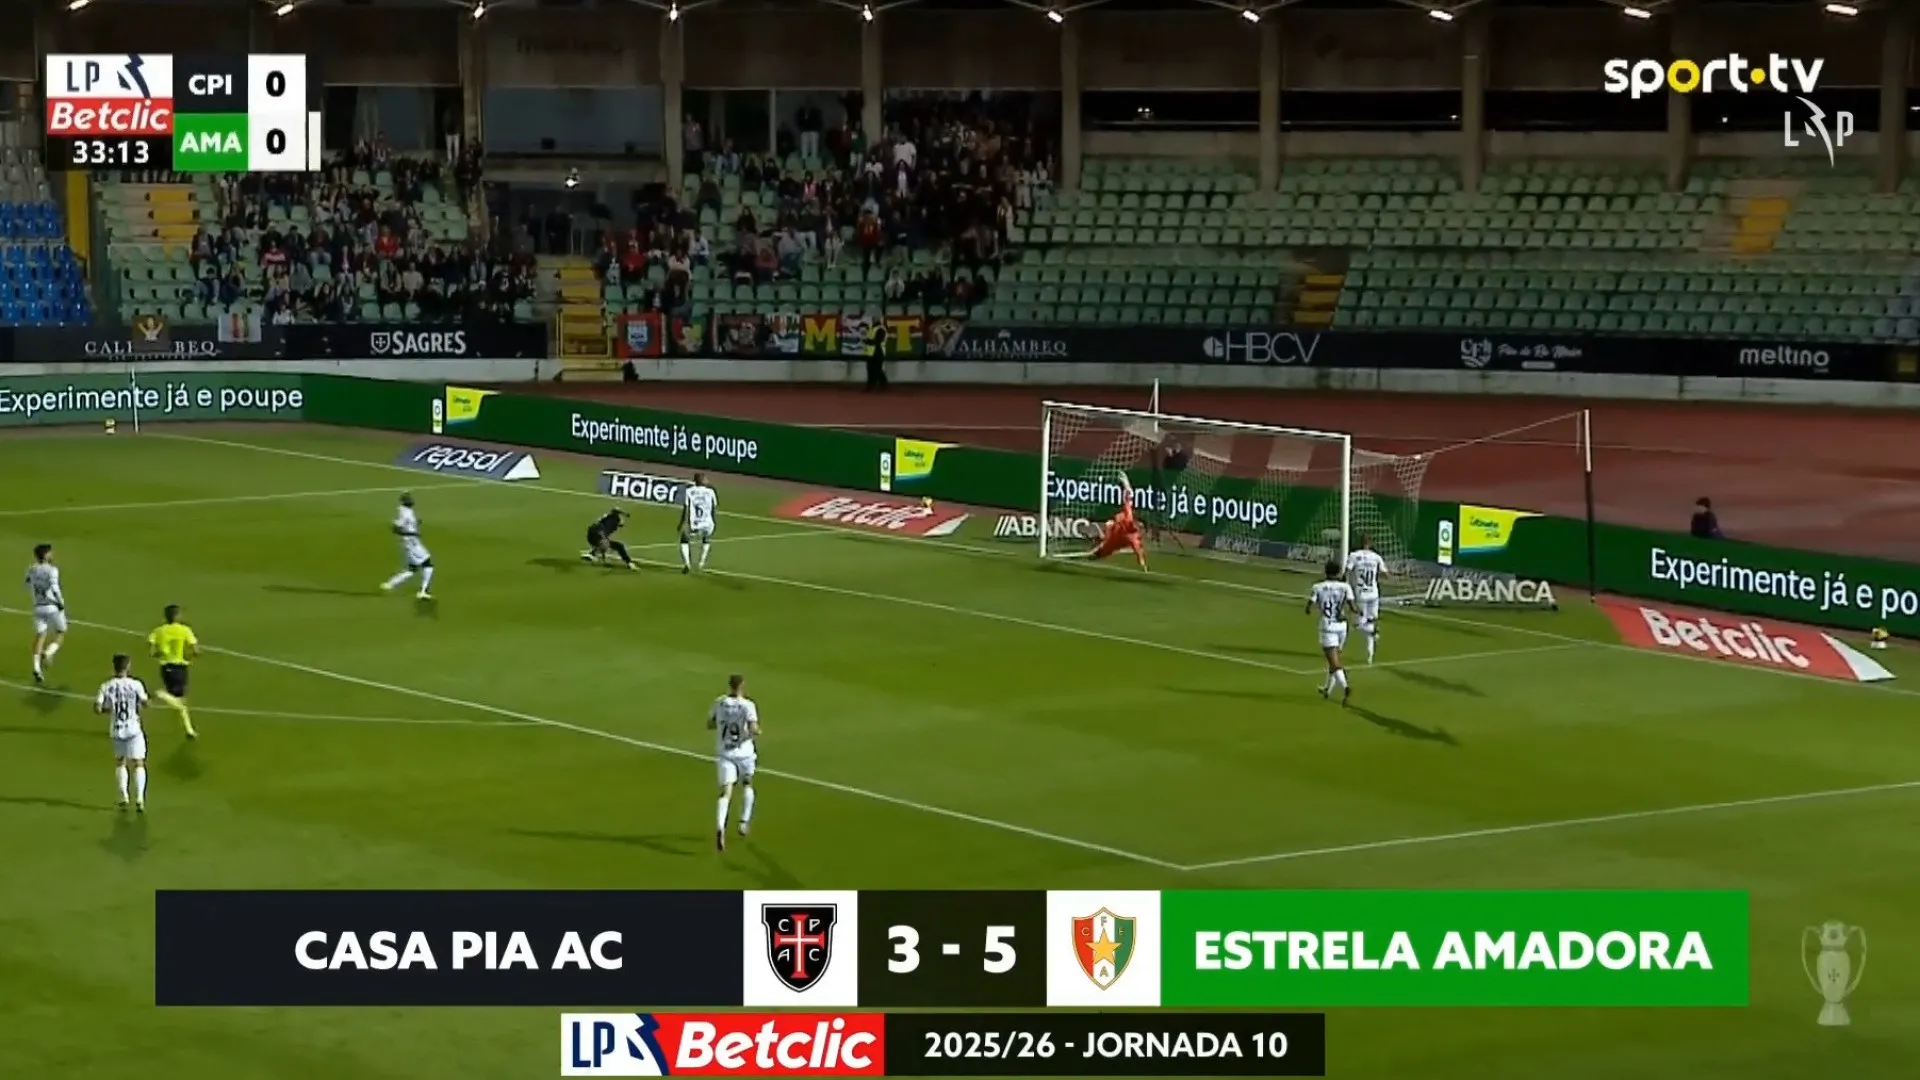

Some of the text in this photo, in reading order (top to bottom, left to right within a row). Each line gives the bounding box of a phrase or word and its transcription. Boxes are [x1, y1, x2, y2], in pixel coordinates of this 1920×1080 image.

[392, 331, 467, 355] SAGRES
[958, 339, 1068, 356] ALHAMBEQ
[0, 383, 304, 417] Experimente já e poupe
[571, 413, 758, 463] Experimente já e poupe
[413, 445, 514, 471] repsol
[611, 473, 678, 503] Haier
[1169, 483, 1189, 519] já
[1194, 494, 1207, 516] e
[1212, 496, 1279, 529] poupe
[1650, 547, 1920, 620] Experimente já e po
[1639, 606, 1811, 669] Betclic
